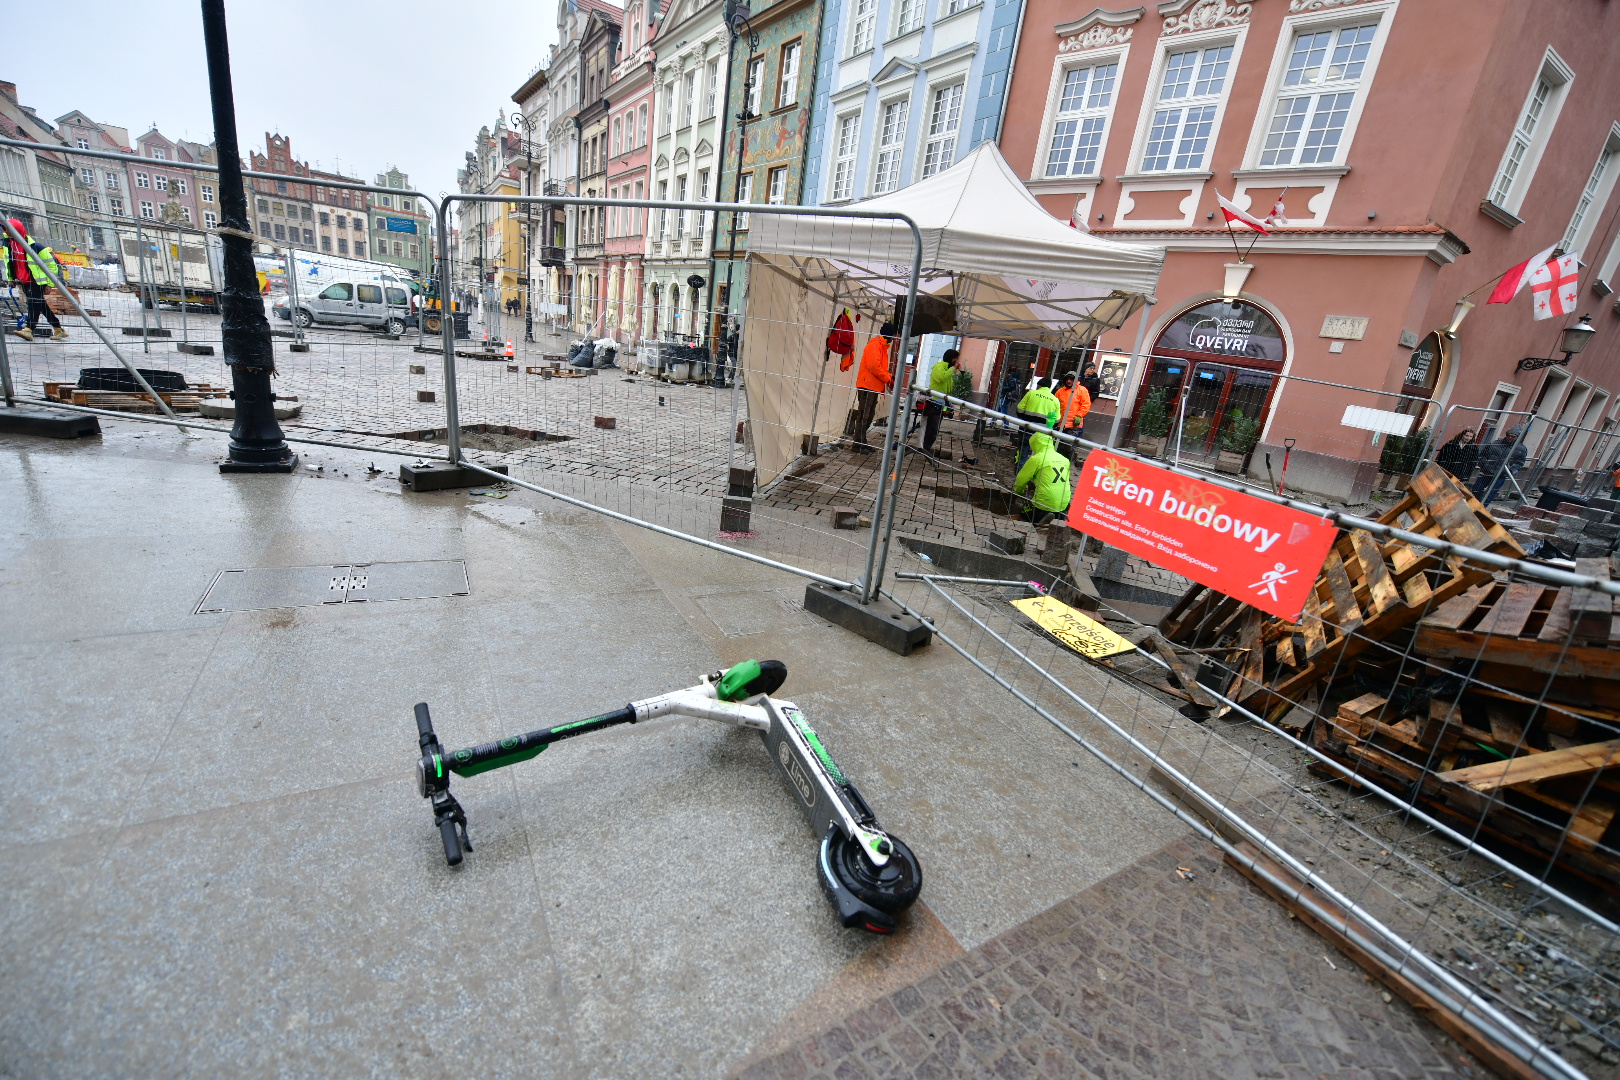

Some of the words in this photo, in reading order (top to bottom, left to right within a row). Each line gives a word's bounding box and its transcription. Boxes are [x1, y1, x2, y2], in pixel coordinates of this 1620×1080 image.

[1327, 318, 1363, 328] STARY
[1196, 335, 1249, 351] QVEVRI
[1088, 496, 1105, 508] Zakaz
[1093, 465, 1154, 507] Teren
[1159, 489, 1281, 553] budowy
[1085, 504, 1121, 523] Construction
[1134, 524, 1151, 536] Entry
[1151, 531, 1184, 548] forbidden
[1157, 543, 1173, 556] Вхід
[1174, 550, 1218, 572] заборонено
[791, 761, 810, 798] Lime
